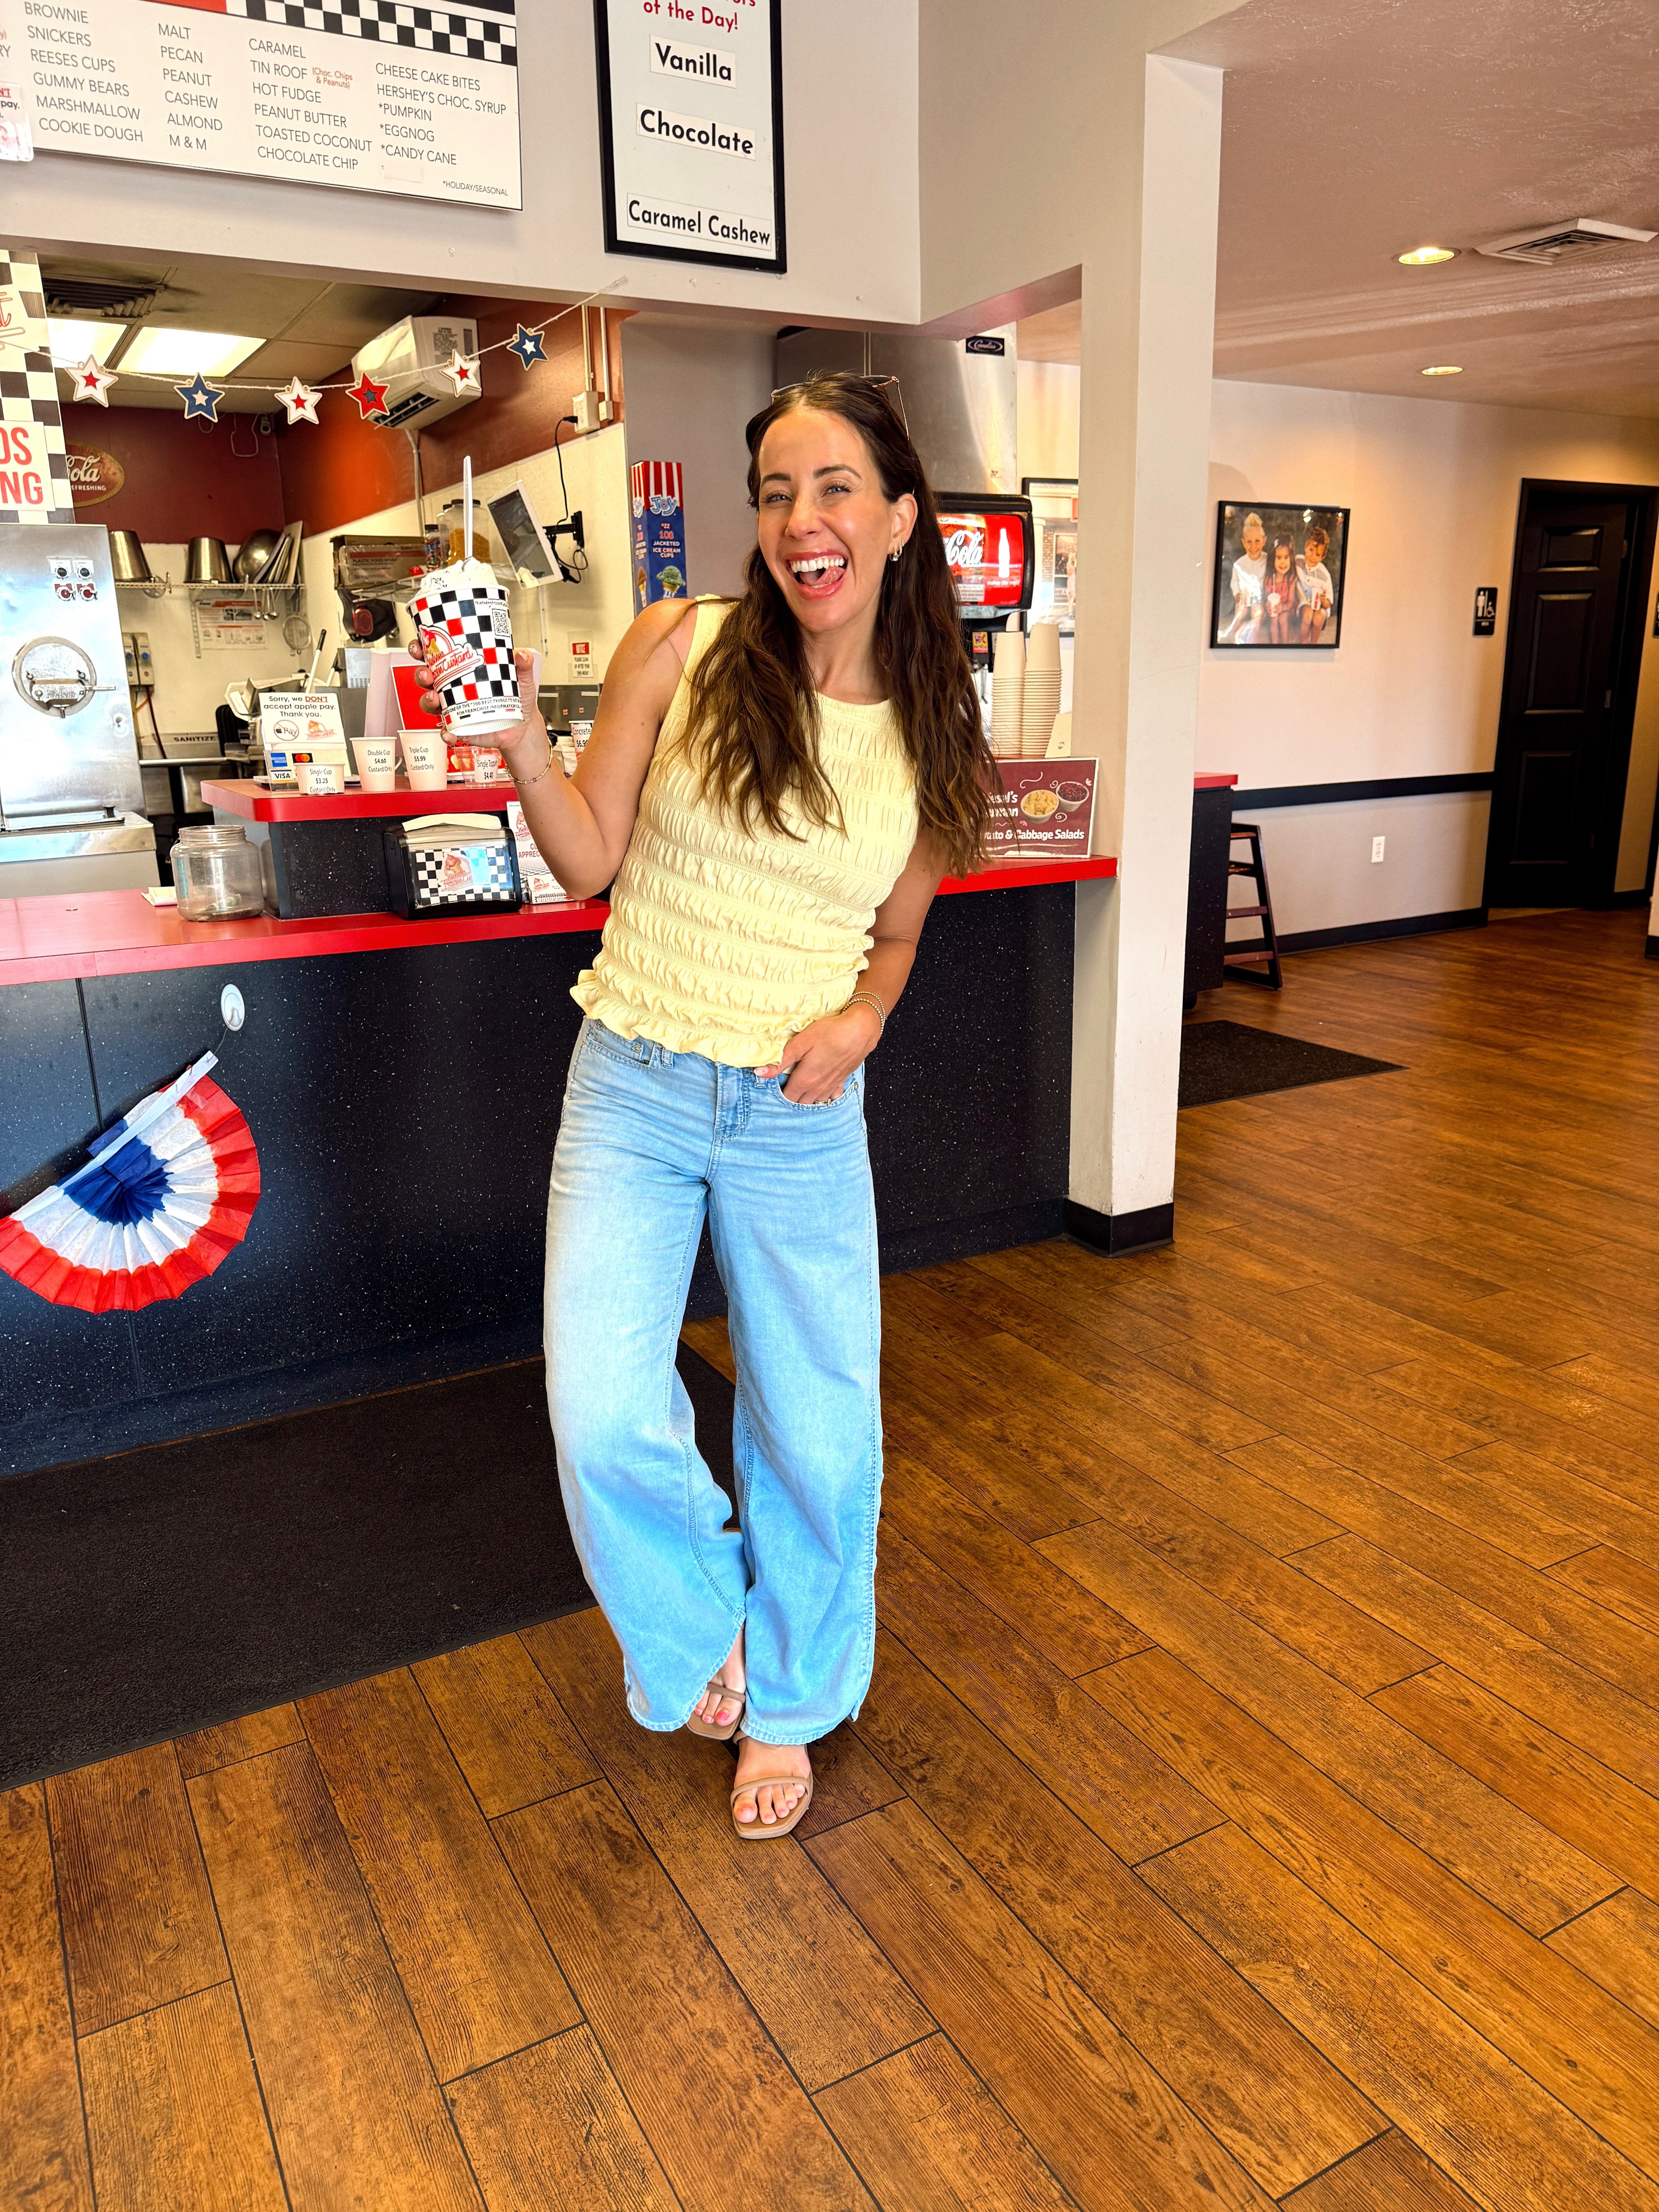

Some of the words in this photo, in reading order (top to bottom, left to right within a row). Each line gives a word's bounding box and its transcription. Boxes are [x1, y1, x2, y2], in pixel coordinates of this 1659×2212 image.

[24, 1, 89, 24] BROWNIE
[644, 0, 661, 14] of
[668, 0, 694, 21] the
[702, 6, 738, 33] Day!
[27, 25, 91, 46] SNICKERS
[158, 23, 191, 40] MALT
[161, 46, 203, 64] PECAN
[249, 38, 306, 58] CARAMEL
[31, 49, 78, 67] REESES
[82, 57, 115, 72] CUPS
[250, 60, 270, 74] TIN
[274, 64, 307, 79] ROOF
[313, 67, 333, 77] (Choc.
[335, 71, 353, 81] Chips
[655, 43, 732, 81] Vanilla
[33, 72, 84, 90] GUMMY
[89, 80, 129, 96] BEARS
[163, 68, 212, 86] PEANUT
[323, 77, 350, 89] Peanuts)
[376, 63, 418, 80] CHEESE
[421, 70, 450, 85] CAKE
[453, 76, 480, 91] BITES
[165, 91, 218, 109] CASHEW
[253, 82, 278, 96] HOT
[282, 86, 321, 103] FUDGE
[377, 84, 434, 103] HERSHEY'S
[438, 94, 472, 110] CHOC.
[475, 100, 506, 115] SYRUP
[1, 101, 20, 110] pay.
[36, 95, 140, 120] MARSHMALLOW
[254, 103, 301, 121] PEANUT
[305, 111, 347, 128] BUTTER
[39, 118, 91, 135] COOKIE
[94, 125, 143, 142] DOUGH
[167, 113, 223, 131] ALMOND
[640, 109, 754, 155] Chocolate
[170, 134, 180, 146] M
[184, 136, 193, 148] &
[196, 138, 206, 150] M
[256, 125, 310, 143] TOASTED
[314, 133, 372, 151] COCONUT
[258, 146, 330, 166] CHOCOLATE
[333, 156, 358, 169] CHIP
[427, 151, 457, 165] CANE
[629, 200, 701, 233] Caramel
[708, 215, 770, 246] Cashew
[650, 495, 677, 515] Joy
[477, 760, 488, 769] Single
[1005, 829, 1013, 840] &
[1014, 829, 1053, 841] Cabbage
[1054, 829, 1085, 840] Salads
